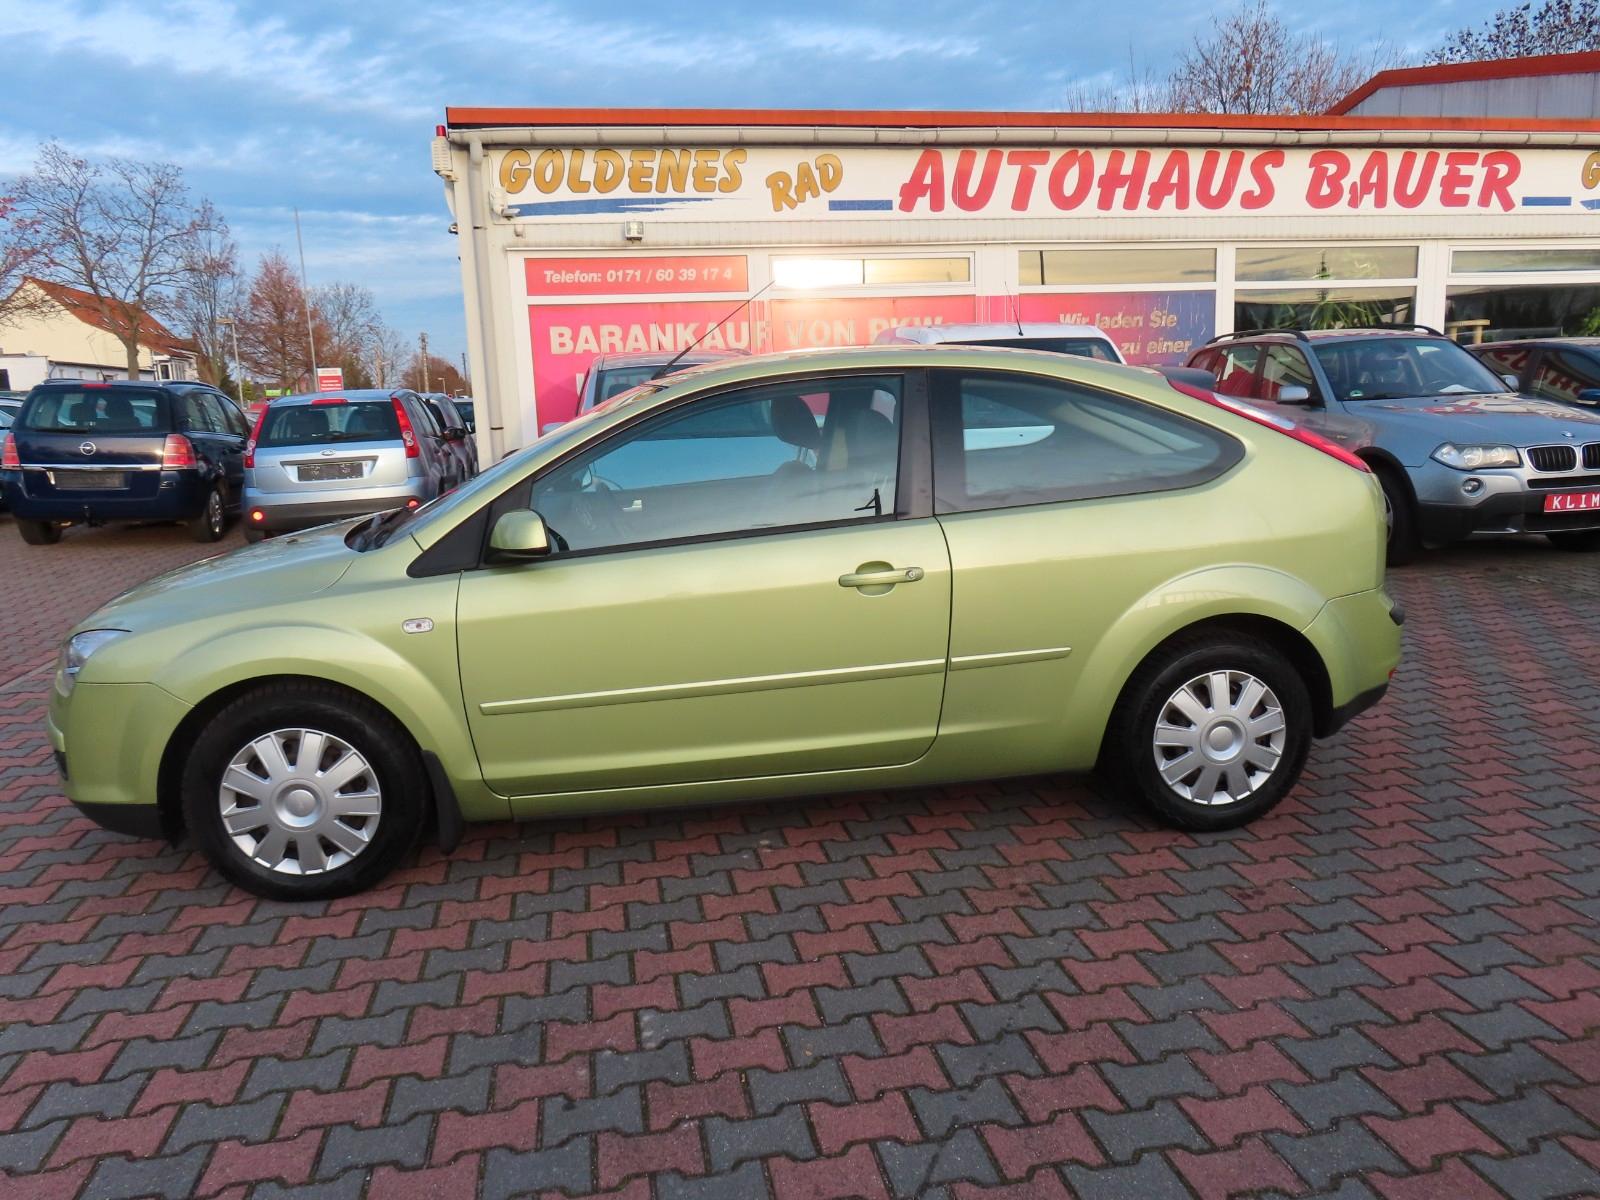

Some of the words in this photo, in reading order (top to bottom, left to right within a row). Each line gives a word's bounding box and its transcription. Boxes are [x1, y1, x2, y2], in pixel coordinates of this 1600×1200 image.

[499, 148, 748, 193] GOLDENES
[767, 153, 843, 211] RAD
[899, 148, 1286, 212] AUTOHAUS
[1306, 149, 1521, 212] BAUER
[543, 270, 602, 284] Telefon:
[606, 269, 641, 282] 0171
[655, 269, 674, 281] 60
[678, 268, 697, 281] 39
[702, 268, 719, 280] 17
[723, 268, 733, 280] 4
[1059, 312, 1090, 325] Wir
[1095, 312, 1144, 329] laden
[1150, 309, 1178, 329] Sie
[549, 320, 774, 354] BARANKAUF
[786, 318, 857, 346] VON
[1120, 341, 1141, 355] zu
[1146, 337, 1193, 354] einer
